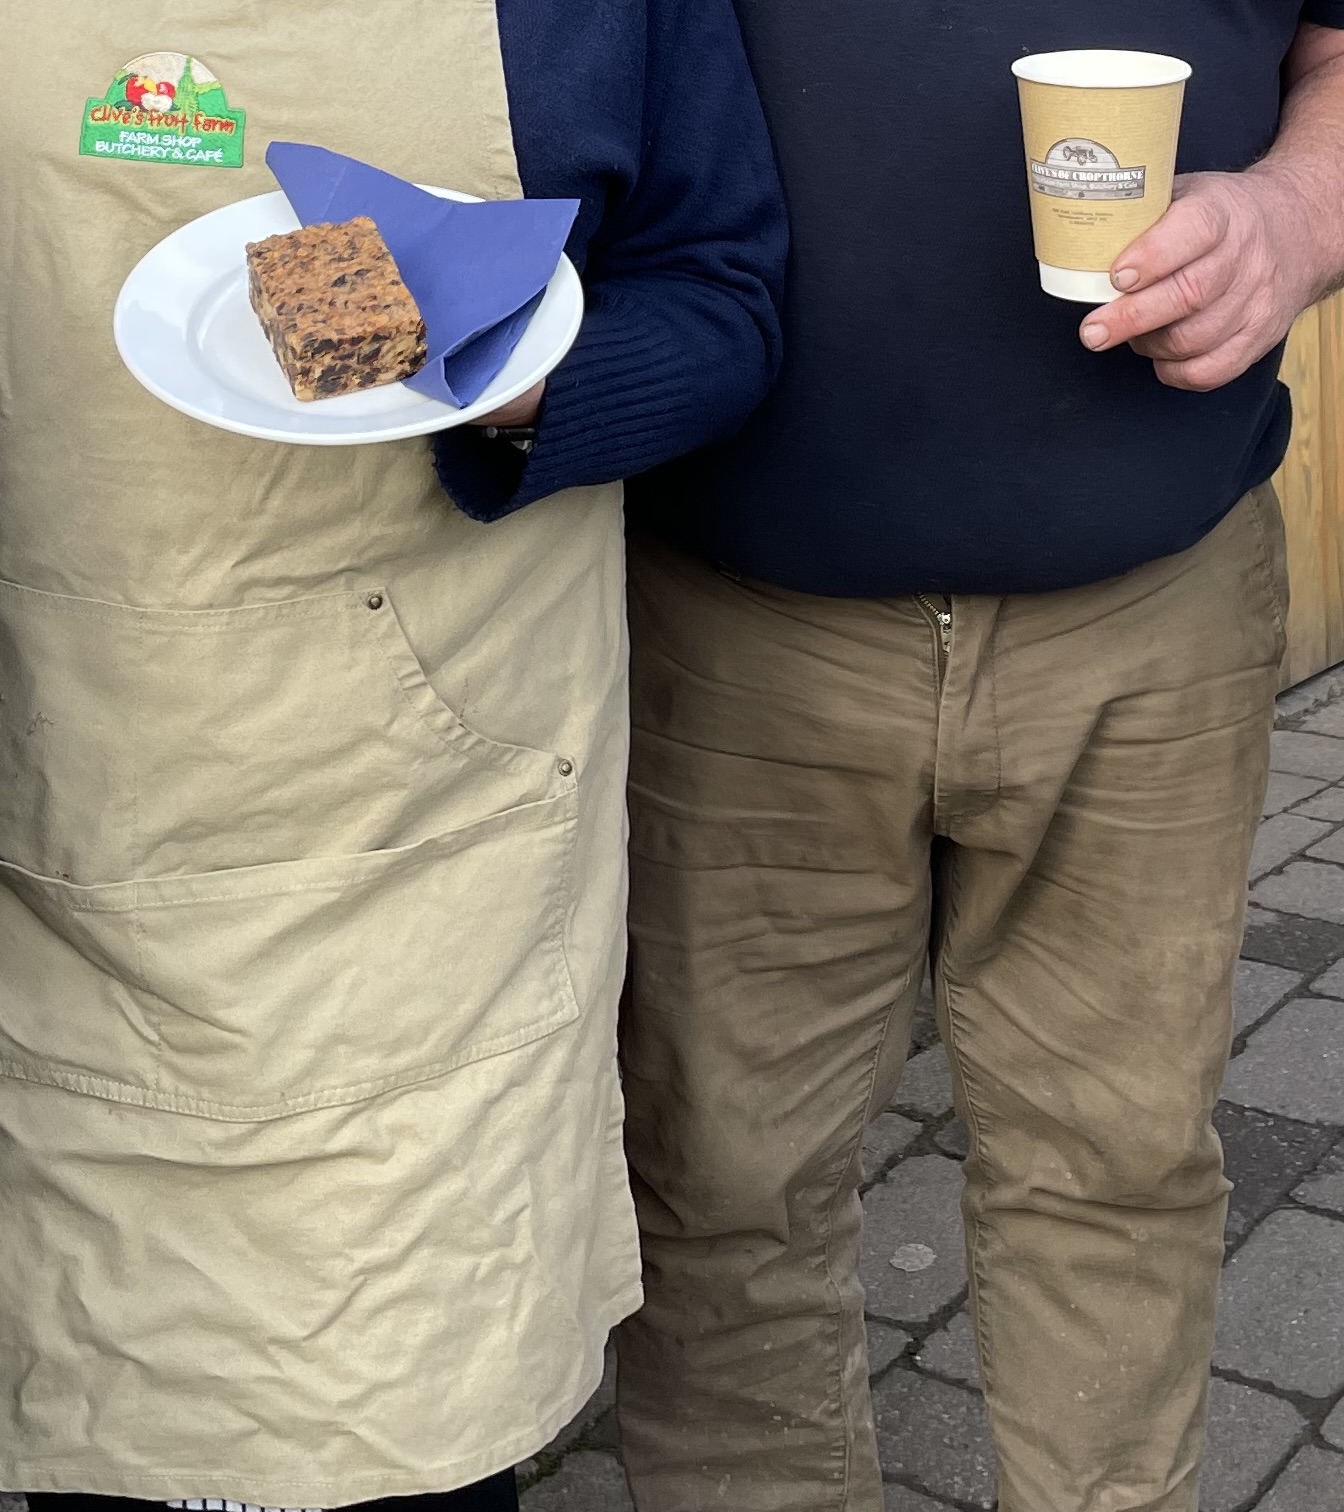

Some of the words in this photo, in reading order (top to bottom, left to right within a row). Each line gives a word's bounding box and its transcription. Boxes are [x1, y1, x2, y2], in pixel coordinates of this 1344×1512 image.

[119, 130, 159, 145] FARM
[161, 134, 202, 148] SHOP
[95, 140, 168, 159] BUTCHERY
[171, 148, 184, 159] &
[184, 147, 224, 163] CAFÉ
[1072, 169, 1144, 183] CROPTHORNE
